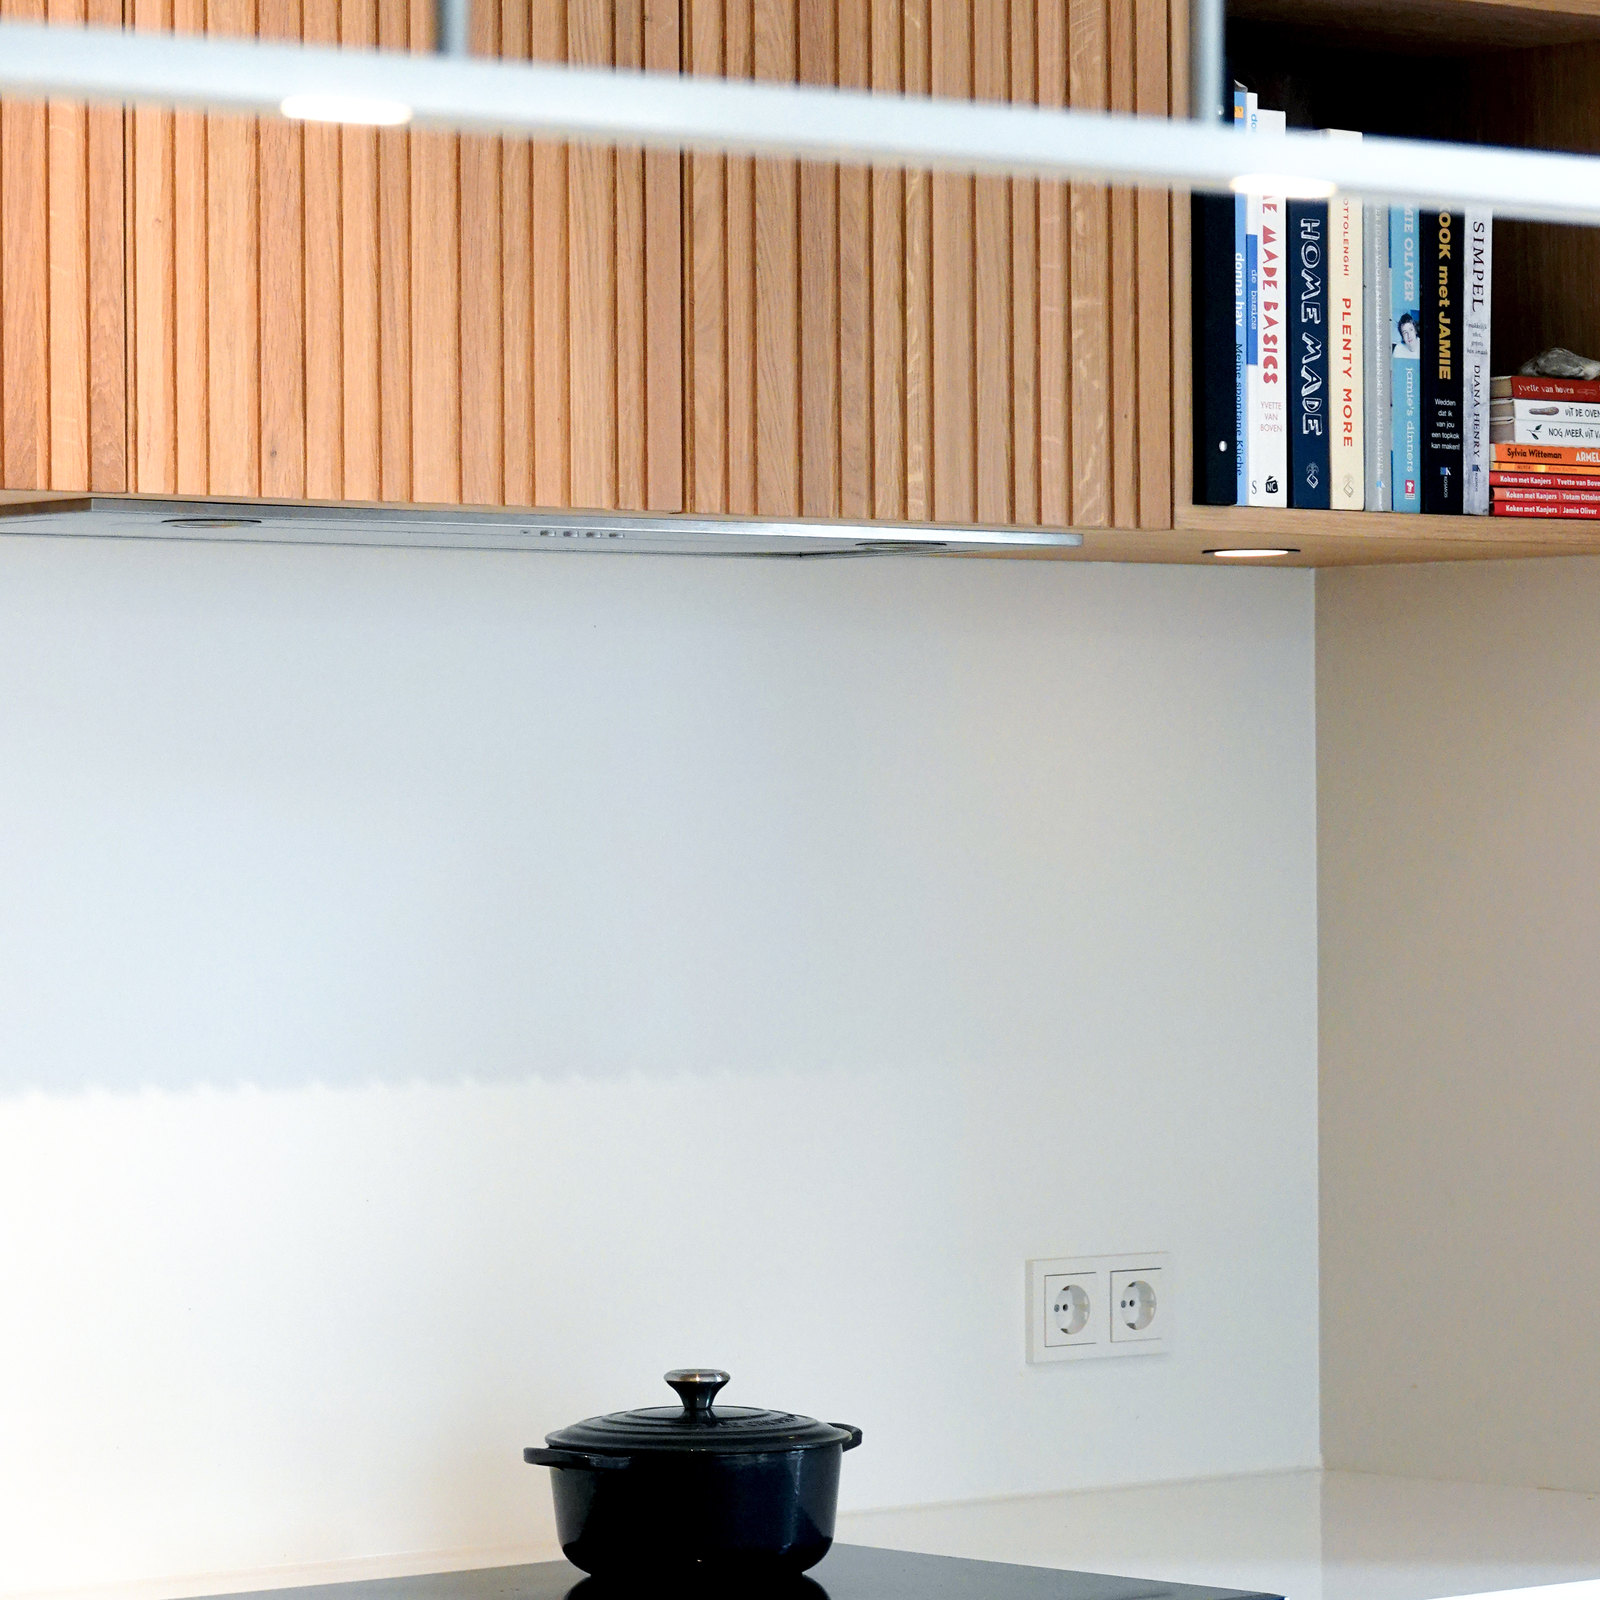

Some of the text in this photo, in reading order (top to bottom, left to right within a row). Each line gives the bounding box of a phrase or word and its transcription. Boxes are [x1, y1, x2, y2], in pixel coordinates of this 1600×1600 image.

[1262, 225, 1279, 290] MADE
[1404, 238, 1414, 302] OLIVER
[1472, 222, 1485, 313] SIMPEL
[1236, 252, 1245, 296] donna
[1438, 209, 1451, 380] OOK met JAMIE
[1301, 218, 1322, 436] HOME MADE
[1263, 301, 1279, 384] BASICS
[1342, 298, 1352, 447] PLENTY MORE
[1518, 384, 1539, 395] yvette
[1260, 402, 1282, 410] YVETTE
[1434, 398, 1456, 406] Wedden
[1576, 409, 1583, 417] DE
[1405, 367, 1415, 472] jamie's dinners
[1260, 424, 1282, 432] BOVEN
[1548, 428, 1562, 437] NOG
[1564, 428, 1584, 438] MEER
[1442, 432, 1460, 440] topkok
[1507, 448, 1562, 459] Sylvia Witteman
[1518, 476, 1530, 484] met
[1530, 476, 1552, 486] Kanjers
[1557, 478, 1575, 486] Yvette
[1536, 492, 1557, 502] Kanjers
[1506, 504, 1523, 512] Koken
[1536, 506, 1557, 514] Kanjers
[1562, 506, 1579, 514] Jamie
